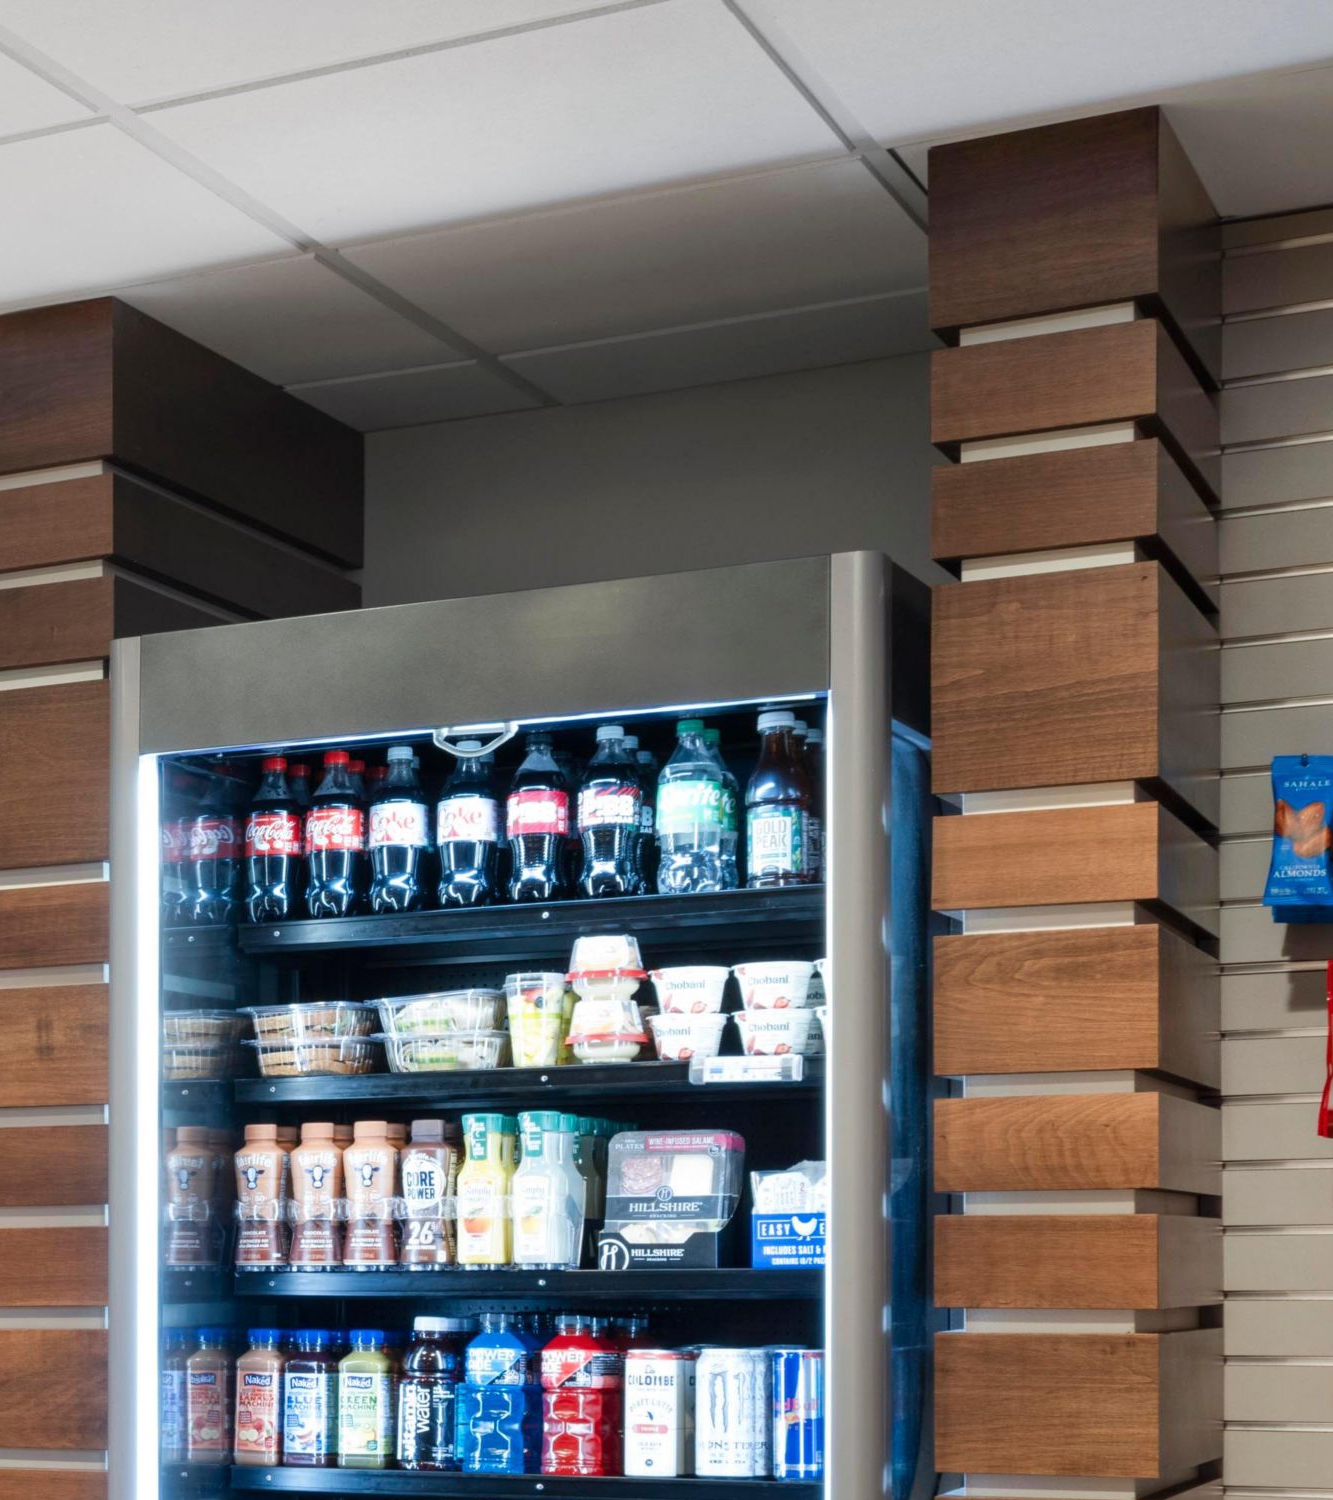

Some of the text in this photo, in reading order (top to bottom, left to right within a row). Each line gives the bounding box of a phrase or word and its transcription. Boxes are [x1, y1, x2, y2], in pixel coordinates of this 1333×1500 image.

[1284, 780, 1332, 789] SAHALE
[369, 811, 416, 831] Coke
[437, 807, 483, 829] Coke
[755, 818, 787, 835] GOLD
[755, 834, 787, 849] PEAK
[1273, 868, 1328, 879] ALMONDS
[664, 979, 706, 991] Chobani
[748, 974, 789, 986] Chobani
[748, 1022, 790, 1033] Chobani
[406, 1170, 436, 1188] CORE
[407, 1187, 436, 1201] POWER
[629, 1202, 703, 1214] HILLSHIRE
[761, 1221, 790, 1237] EASY
[631, 1248, 685, 1258] HILLSHIRE
[763, 1245, 815, 1256] INCLUDES SALT
[416, 1385, 431, 1434] water
